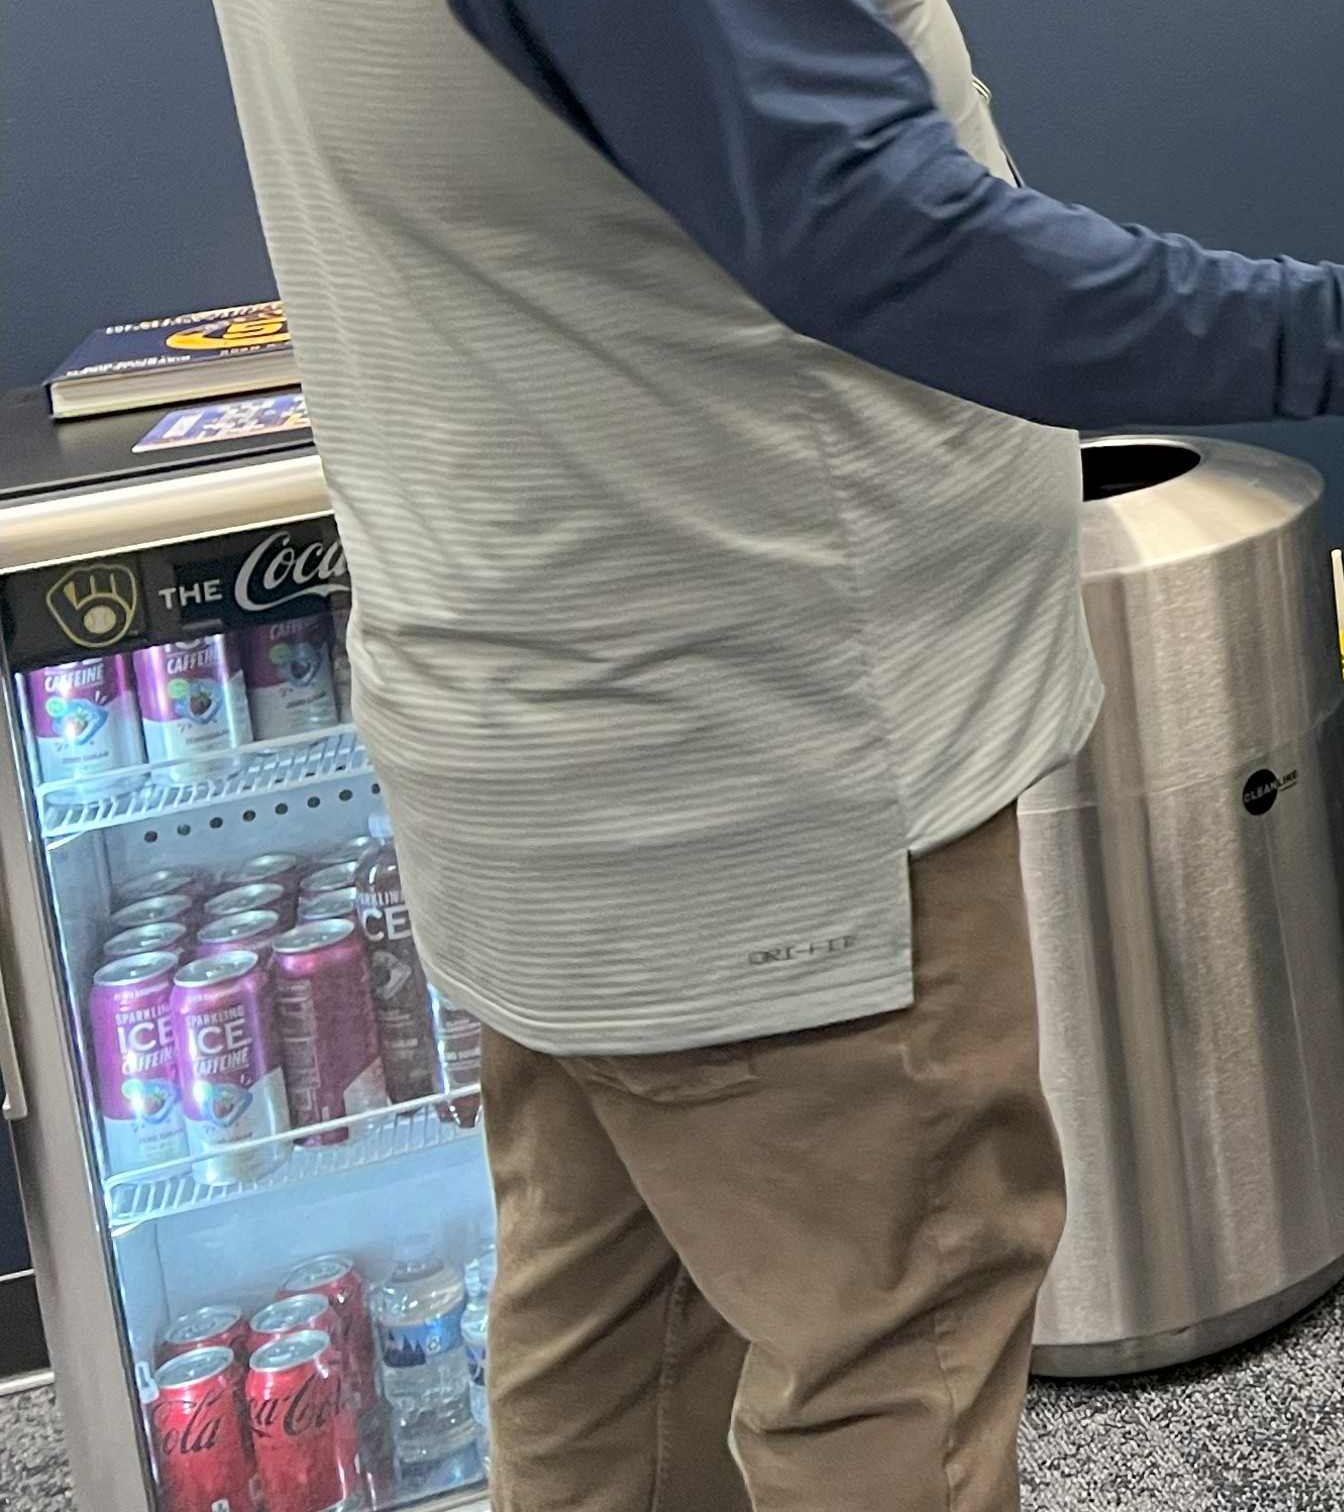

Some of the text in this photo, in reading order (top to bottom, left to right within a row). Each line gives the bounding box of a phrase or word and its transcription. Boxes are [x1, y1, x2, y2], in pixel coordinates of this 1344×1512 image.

[159, 579, 223, 610] THE
[361, 906, 412, 942] CE
[117, 1017, 175, 1055] ICE
[188, 1018, 252, 1060] ICE
[122, 1044, 174, 1076] CAFFEIN
